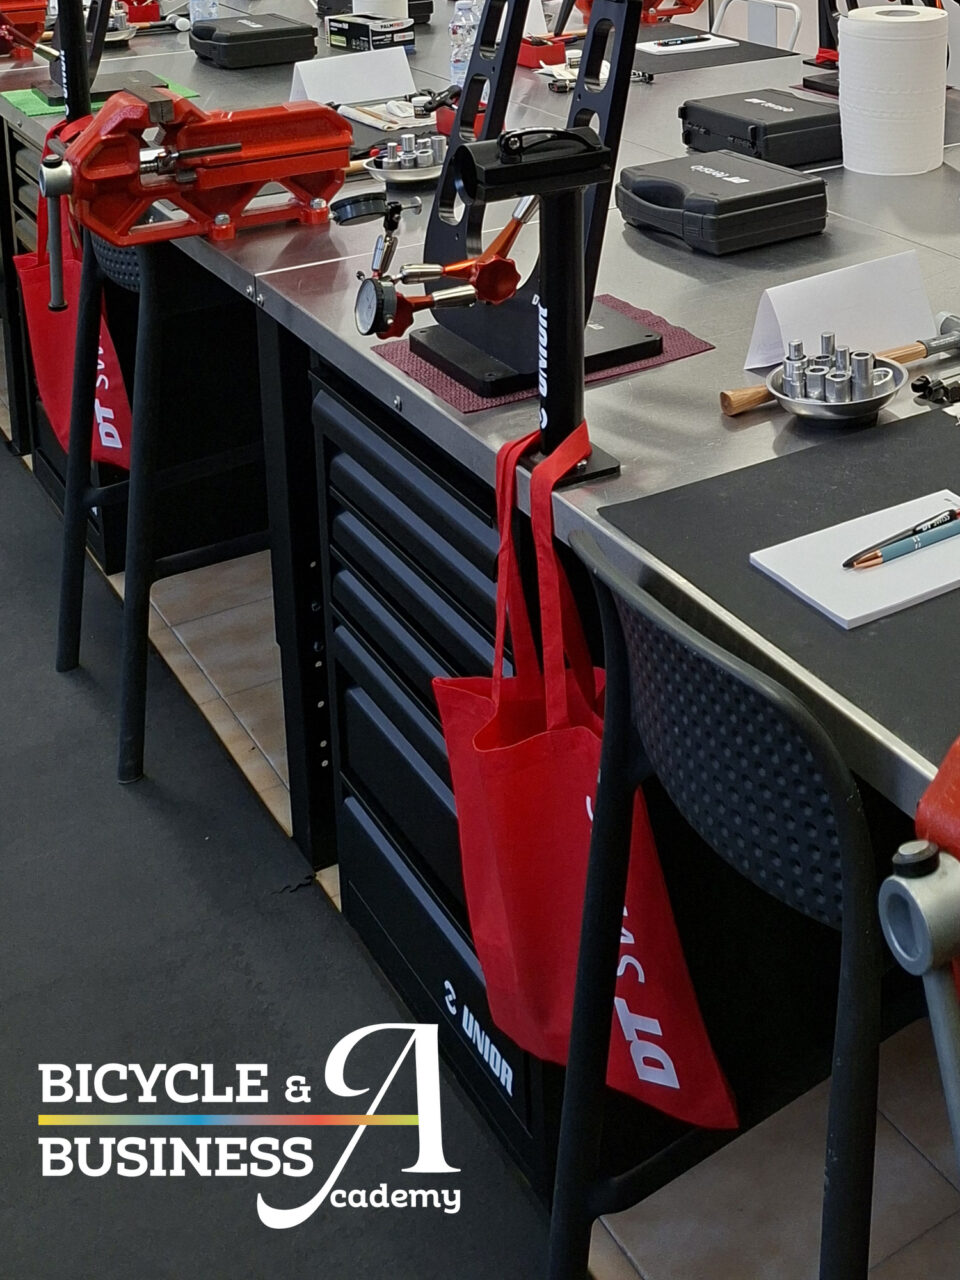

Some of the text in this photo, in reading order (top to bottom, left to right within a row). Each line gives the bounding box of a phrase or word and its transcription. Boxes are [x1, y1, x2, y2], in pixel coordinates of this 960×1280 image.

[95, 398, 123, 449] DT
[462, 1005, 514, 1098] UNIOR
[613, 996, 681, 1090] DT
